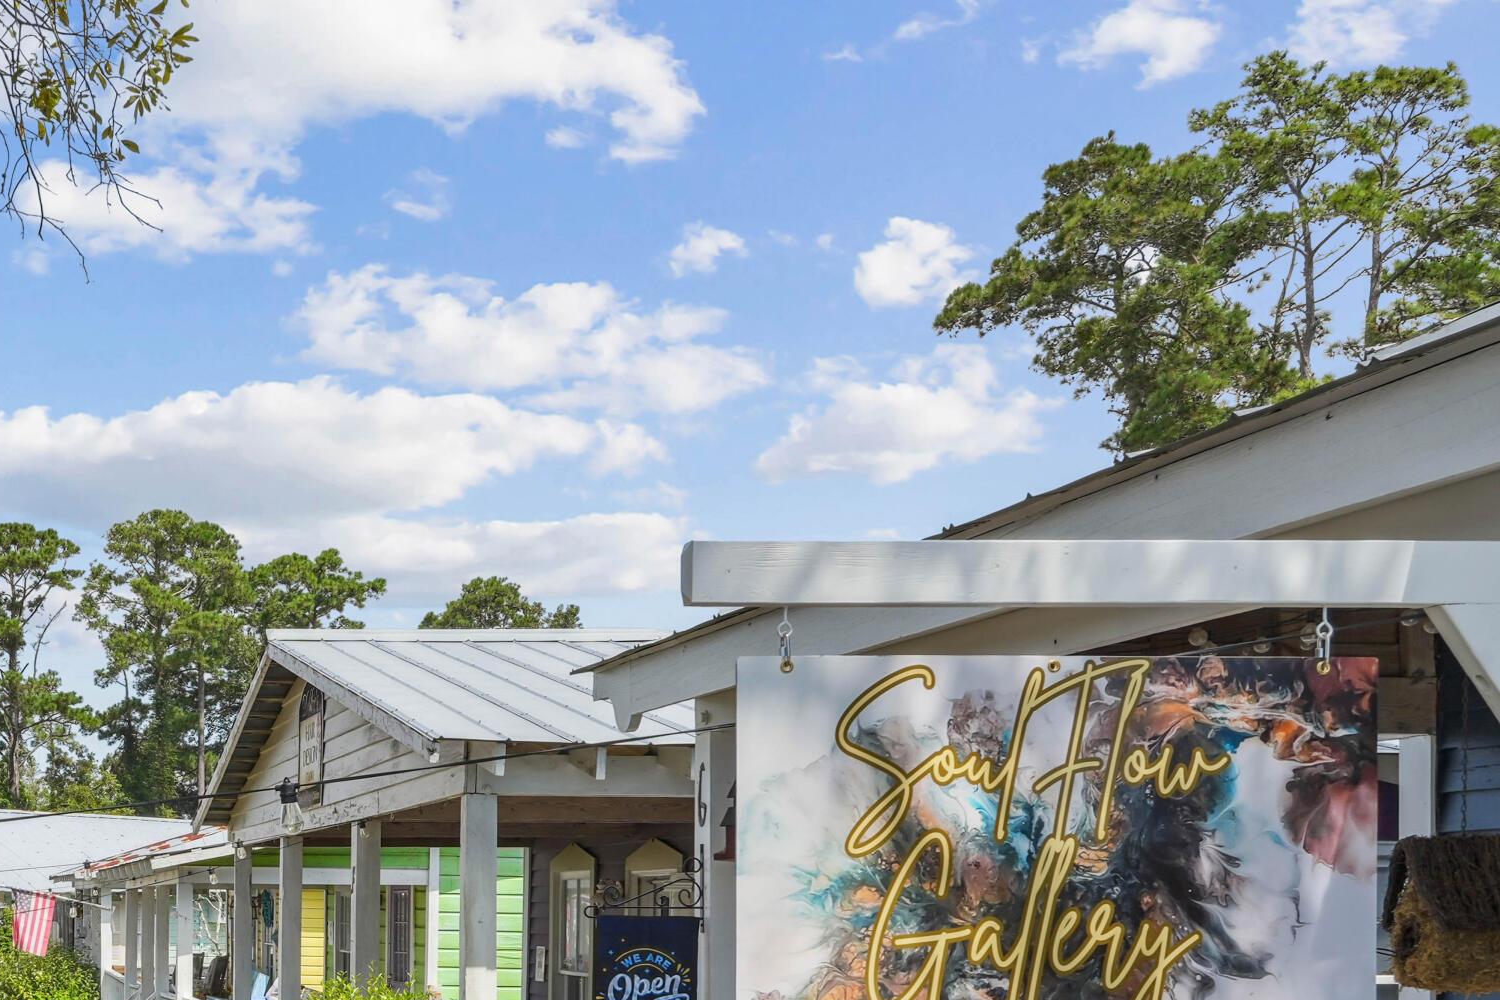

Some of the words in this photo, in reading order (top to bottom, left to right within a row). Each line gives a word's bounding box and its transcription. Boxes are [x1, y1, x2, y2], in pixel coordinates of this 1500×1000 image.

[835, 664, 1045, 859] Soul
[1029, 658, 1231, 848] Flow
[621, 953, 642, 968] WE
[646, 953, 672, 970] ARE
